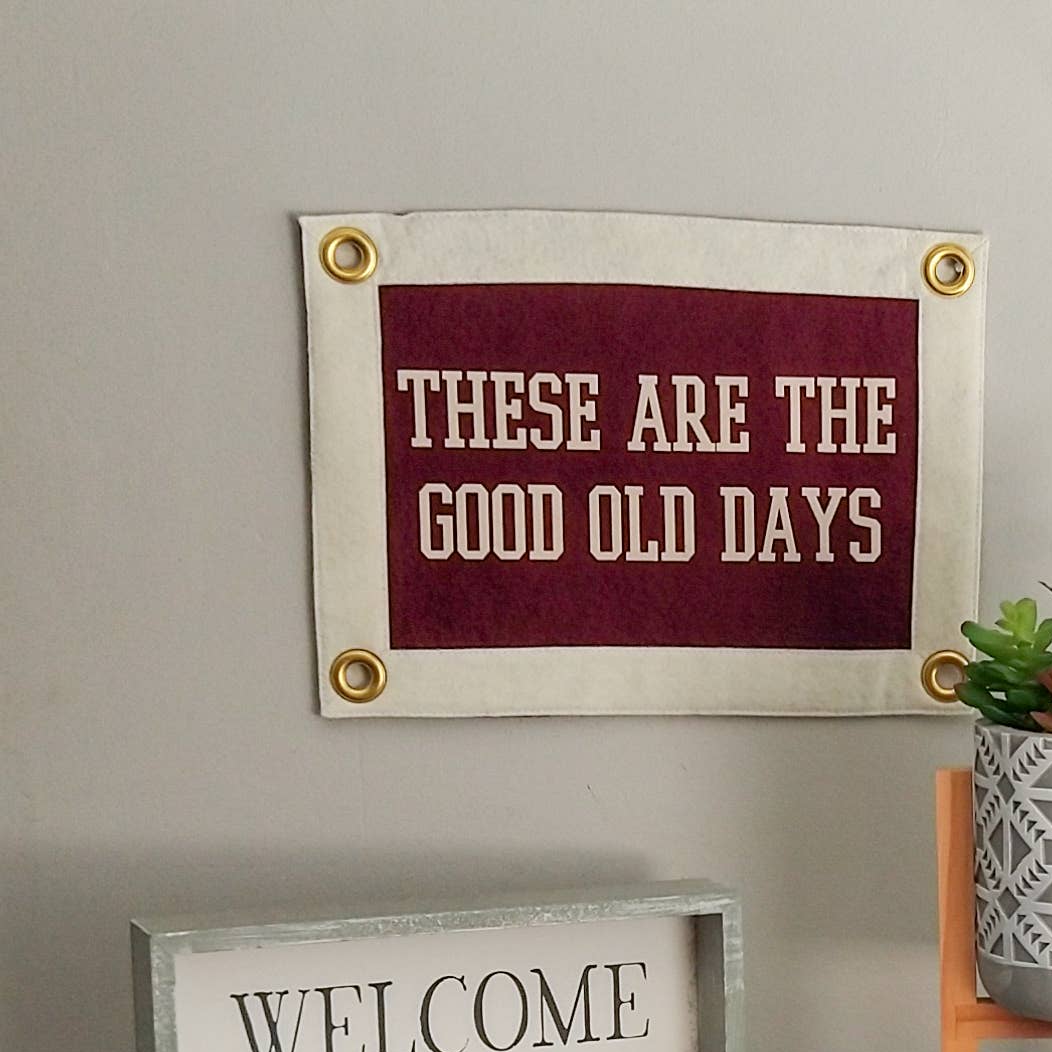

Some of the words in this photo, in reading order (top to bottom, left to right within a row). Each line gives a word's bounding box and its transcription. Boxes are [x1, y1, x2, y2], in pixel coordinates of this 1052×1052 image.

[397, 370, 600, 450] THESE
[628, 375, 749, 452] ARE
[775, 376, 896, 453] THE
[419, 483, 563, 560] GOOD
[589, 485, 695, 561] OLD
[720, 487, 881, 562] DAYS
